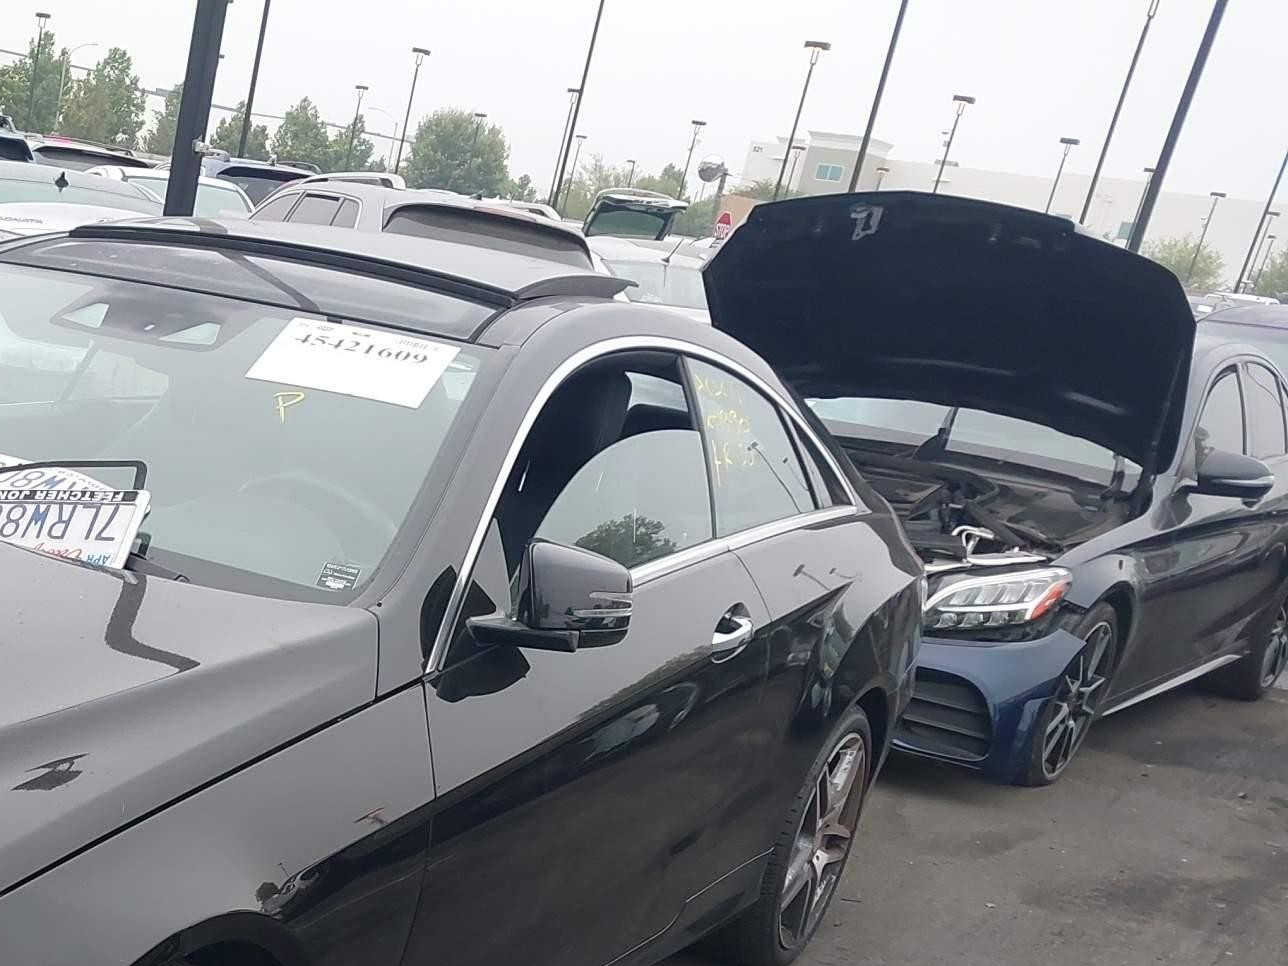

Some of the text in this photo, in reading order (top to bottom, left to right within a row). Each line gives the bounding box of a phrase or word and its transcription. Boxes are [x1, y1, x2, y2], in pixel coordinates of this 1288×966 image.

[714, 223, 730, 239] STOP
[295, 333, 428, 364] 45421609
[273, 392, 305, 424] P
